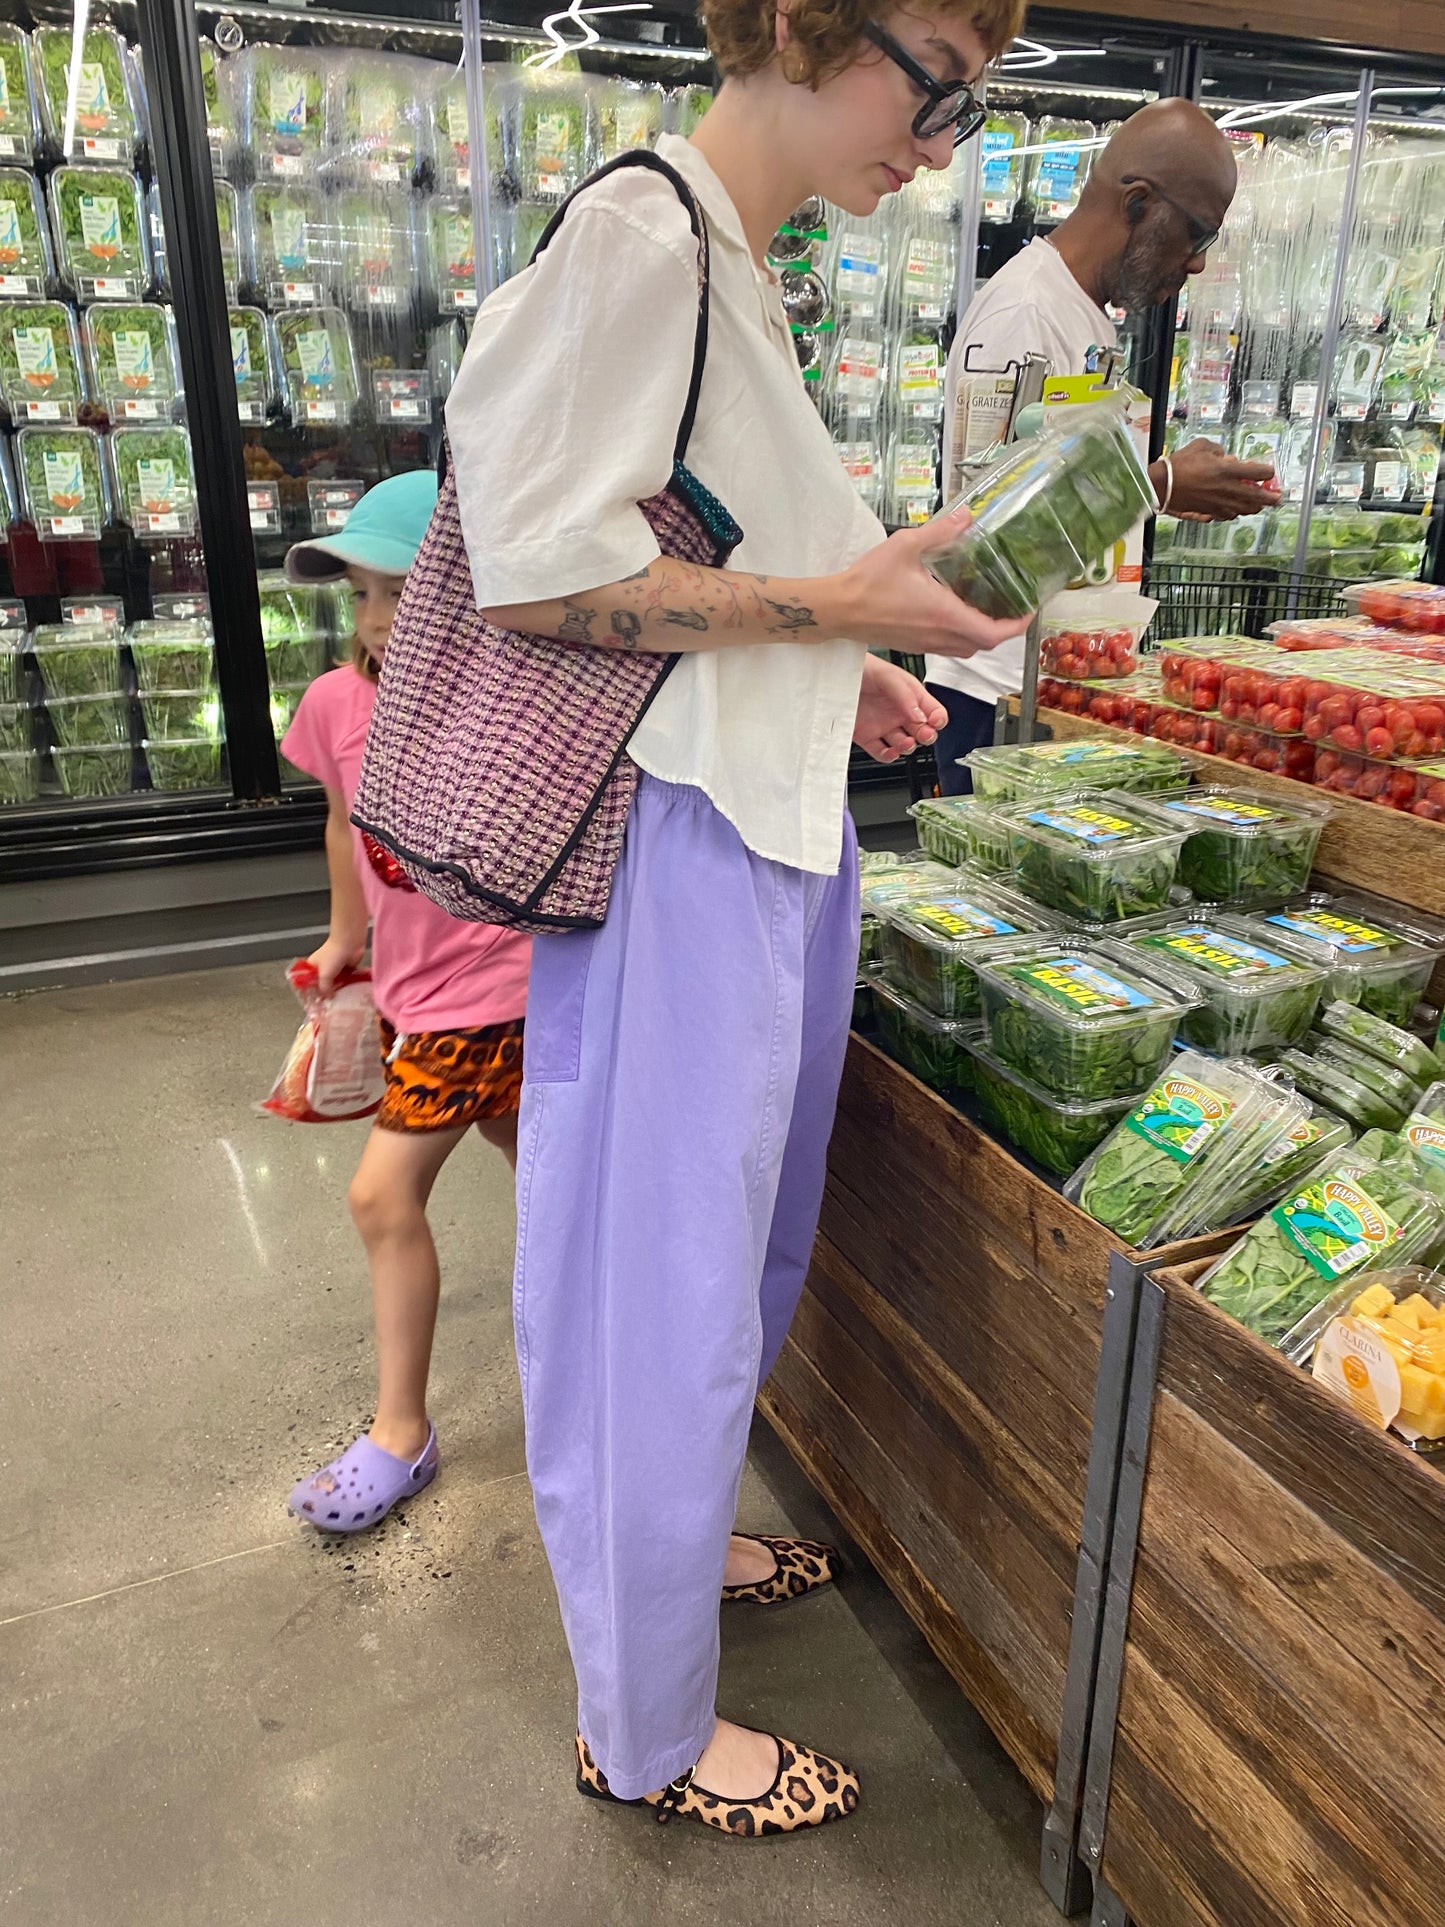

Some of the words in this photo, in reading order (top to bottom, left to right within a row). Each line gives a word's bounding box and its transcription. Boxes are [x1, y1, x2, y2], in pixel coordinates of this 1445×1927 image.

[972, 395, 998, 408] GRATE
[1069, 807, 1133, 831] BASIL
[1206, 799, 1273, 816] BASIL
[915, 906, 973, 933] BASIL
[1310, 913, 1386, 940] BASIL
[1165, 938, 1242, 968] BASIL
[1029, 969, 1103, 1005] BASIL
[1169, 1083, 1197, 1098] HAPPY
[1195, 1091, 1220, 1115] VALLEY
[1415, 1128, 1445, 1145] HAPP
[1330, 1184, 1362, 1206] HAPPY
[1357, 1204, 1384, 1235] VALLEY
[1333, 1211, 1351, 1227] Basil
[1339, 1326, 1382, 1362] CLARINA
